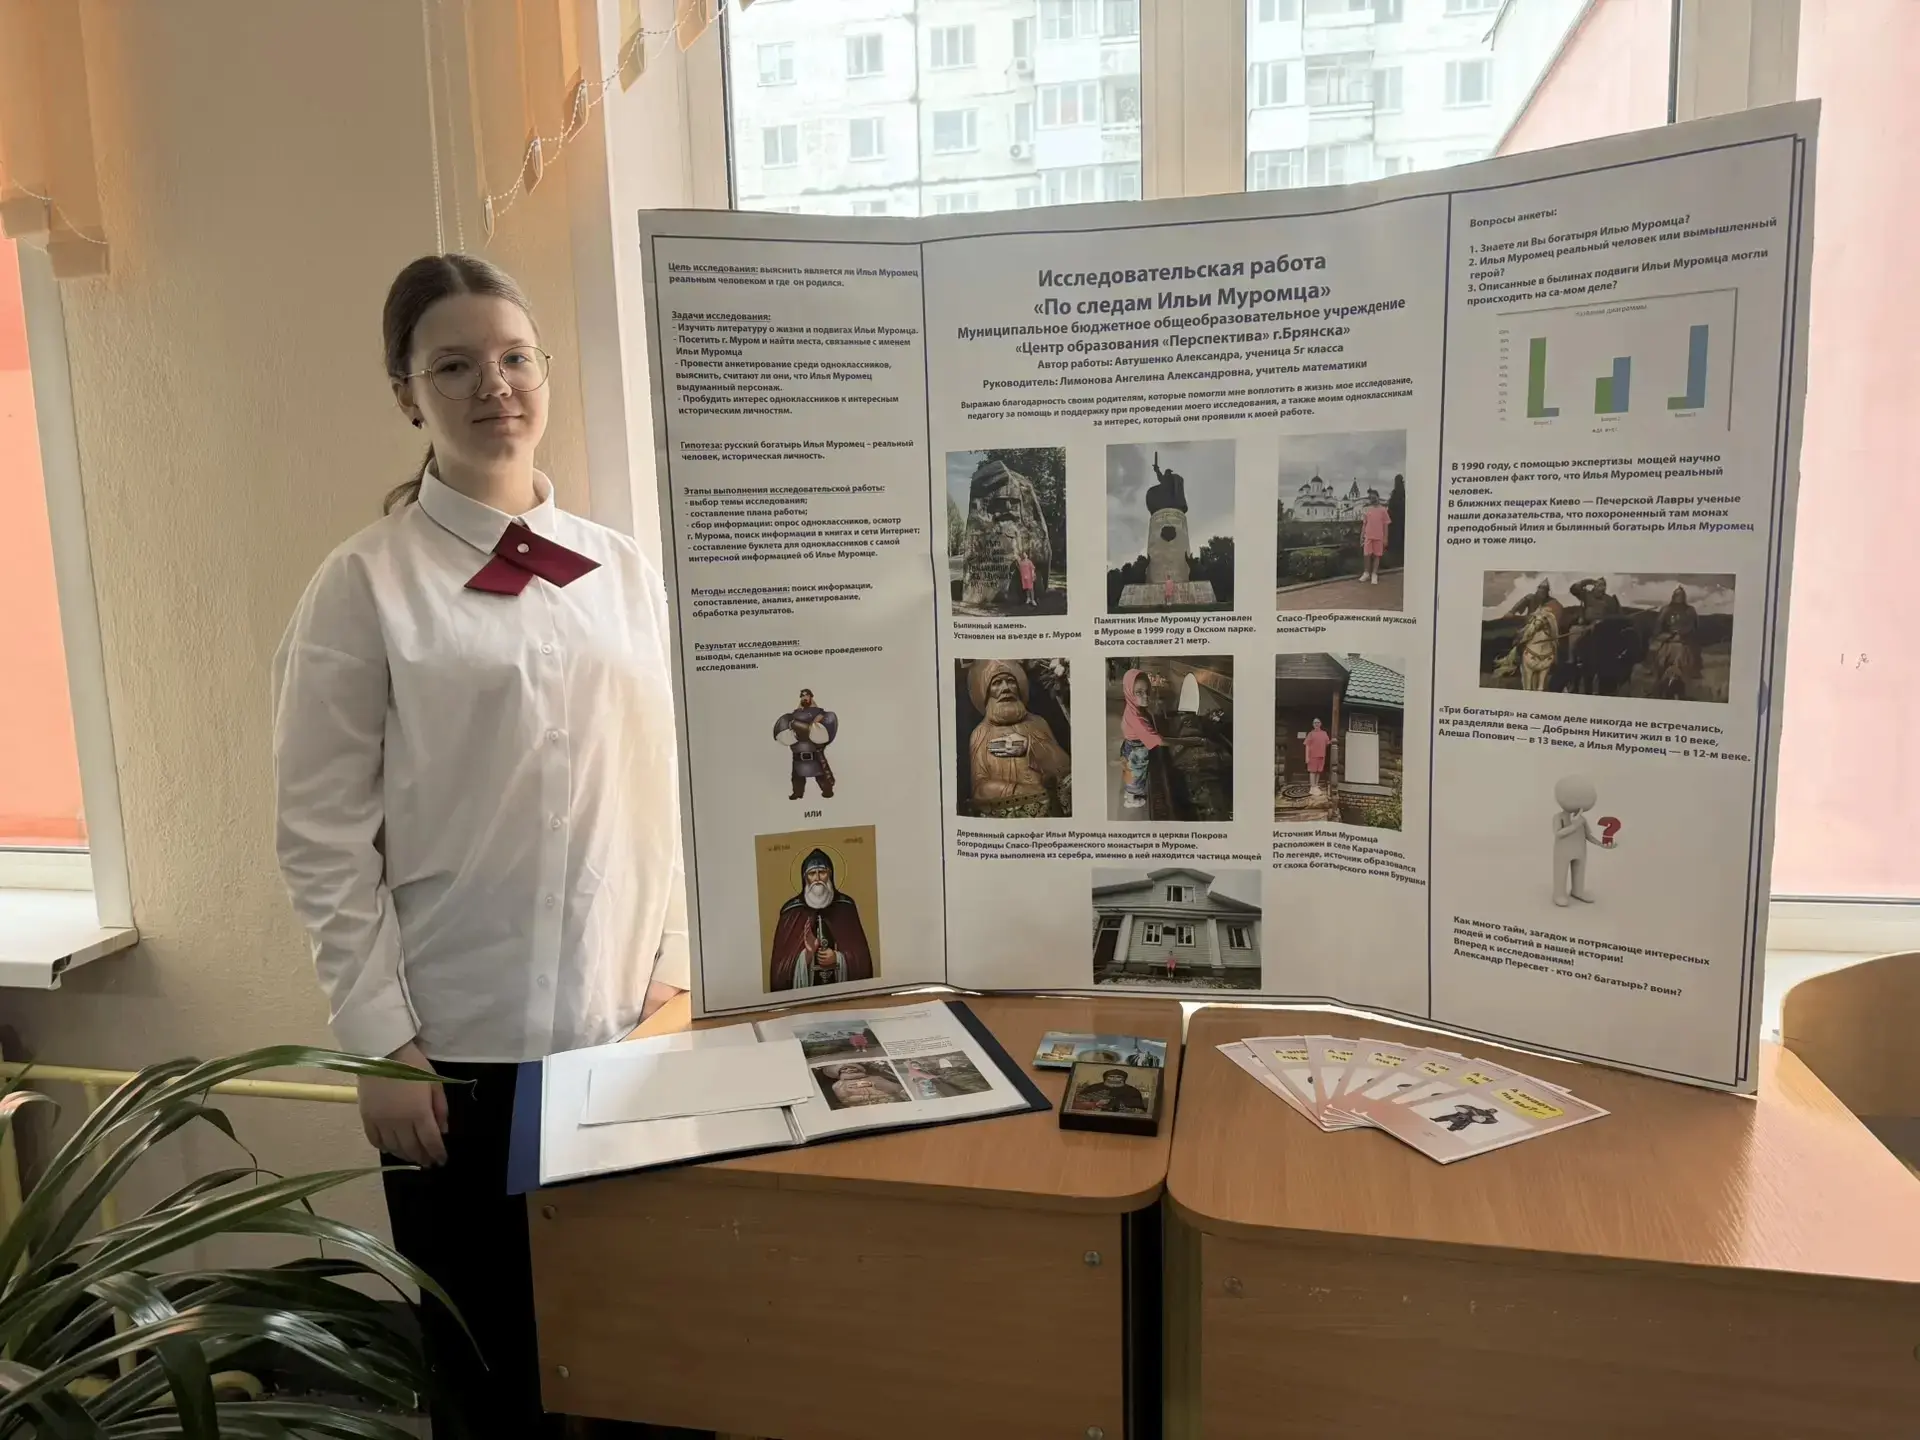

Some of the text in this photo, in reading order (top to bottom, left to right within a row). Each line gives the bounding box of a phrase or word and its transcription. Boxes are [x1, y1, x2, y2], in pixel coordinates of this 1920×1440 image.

[1469, 209, 1557, 227] Вопросы анкеты:
[1468, 216, 1777, 266] 2. Илья Муромец реальный человек или вымышленный
[1470, 214, 1690, 254] 1. Знаете ли Вы богатыря Илью Муромца?
[668, 262, 692, 273] Цель
[692, 264, 759, 275] исследования:
[759, 266, 802, 274] выяснить
[803, 267, 843, 275] является
[878, 269, 918, 279] Муромец
[1038, 253, 1326, 288] Исследовательская работа
[1469, 267, 1505, 280] герой?
[668, 276, 717, 284] реальным
[805, 279, 844, 287] родился.
[1467, 280, 1617, 306] происходить на са-мом деле?
[1034, 285, 1330, 316] «По следам Ильи Муромца»
[671, 310, 771, 322] Задачи исследования:
[957, 298, 1405, 341] Муниципальное бюджетное общеобразовательное учреждение
[1015, 326, 1350, 355] «Центр образования «Перспектива» г.Брянска»
[1037, 345, 1344, 370] Автор работы: Автушенко Александра, ученица 5г класса
[982, 360, 1367, 390] Руководитель: Лимонова Ангелина Александровна, учитель математики
[678, 408, 742, 416] историческим
[721, 453, 782, 461] историческая
[1451, 462, 1459, 470] В
[1461, 461, 1485, 470] 1990
[1486, 462, 1511, 471] году,
[1519, 460, 1570, 468] помощью
[1571, 458, 1633, 468] экспертизы
[1637, 454, 1677, 465] мощей
[1678, 454, 1721, 464] научно
[683, 483, 885, 496] Этапы выполнения исследовательской работы:
[1446, 537, 1472, 545] одно
[690, 588, 726, 597] Методы
[727, 586, 790, 596] исследования:
[817, 583, 873, 591] информации,
[692, 607, 794, 618] обработка результатов.
[1093, 616, 1137, 624] Памятник
[1160, 615, 1201, 624] Муромцу
[1202, 615, 1252, 623] установлен
[1276, 612, 1417, 624] Спасо-Преображенский мужской
[953, 621, 992, 629] Былинный
[1100, 627, 1136, 636] Муроме
[1144, 626, 1164, 634] 1999
[1165, 627, 1185, 635] году
[1193, 625, 1226, 633] Окском
[1227, 626, 1256, 634] парке.
[953, 631, 995, 640] Установлен
[1052, 630, 1082, 639] Муром
[694, 639, 800, 651] Результат исследования:
[695, 653, 734, 661] выводы,
[734, 651, 781, 660] сделанные
[824, 645, 883, 655] проведенного
[695, 663, 758, 671] исследования.
[1438, 705, 1461, 715] «Три
[1462, 706, 1514, 718] богатыря»
[1529, 713, 1562, 721] самом
[1562, 715, 1588, 723] деле
[1589, 717, 1633, 728] никогда
[1650, 721, 1723, 734] встречались,
[803, 810, 822, 818] или
[1314, 829, 1338, 837] Ильи
[1337, 831, 1378, 844] Муромца
[1453, 928, 1484, 938] людей
[1492, 934, 1535, 947] событий
[1543, 939, 1577, 955] нашей
[1577, 947, 1624, 963] истории!
[1453, 937, 1488, 951] Вперед
[1496, 946, 1574, 966] исследованиям!
